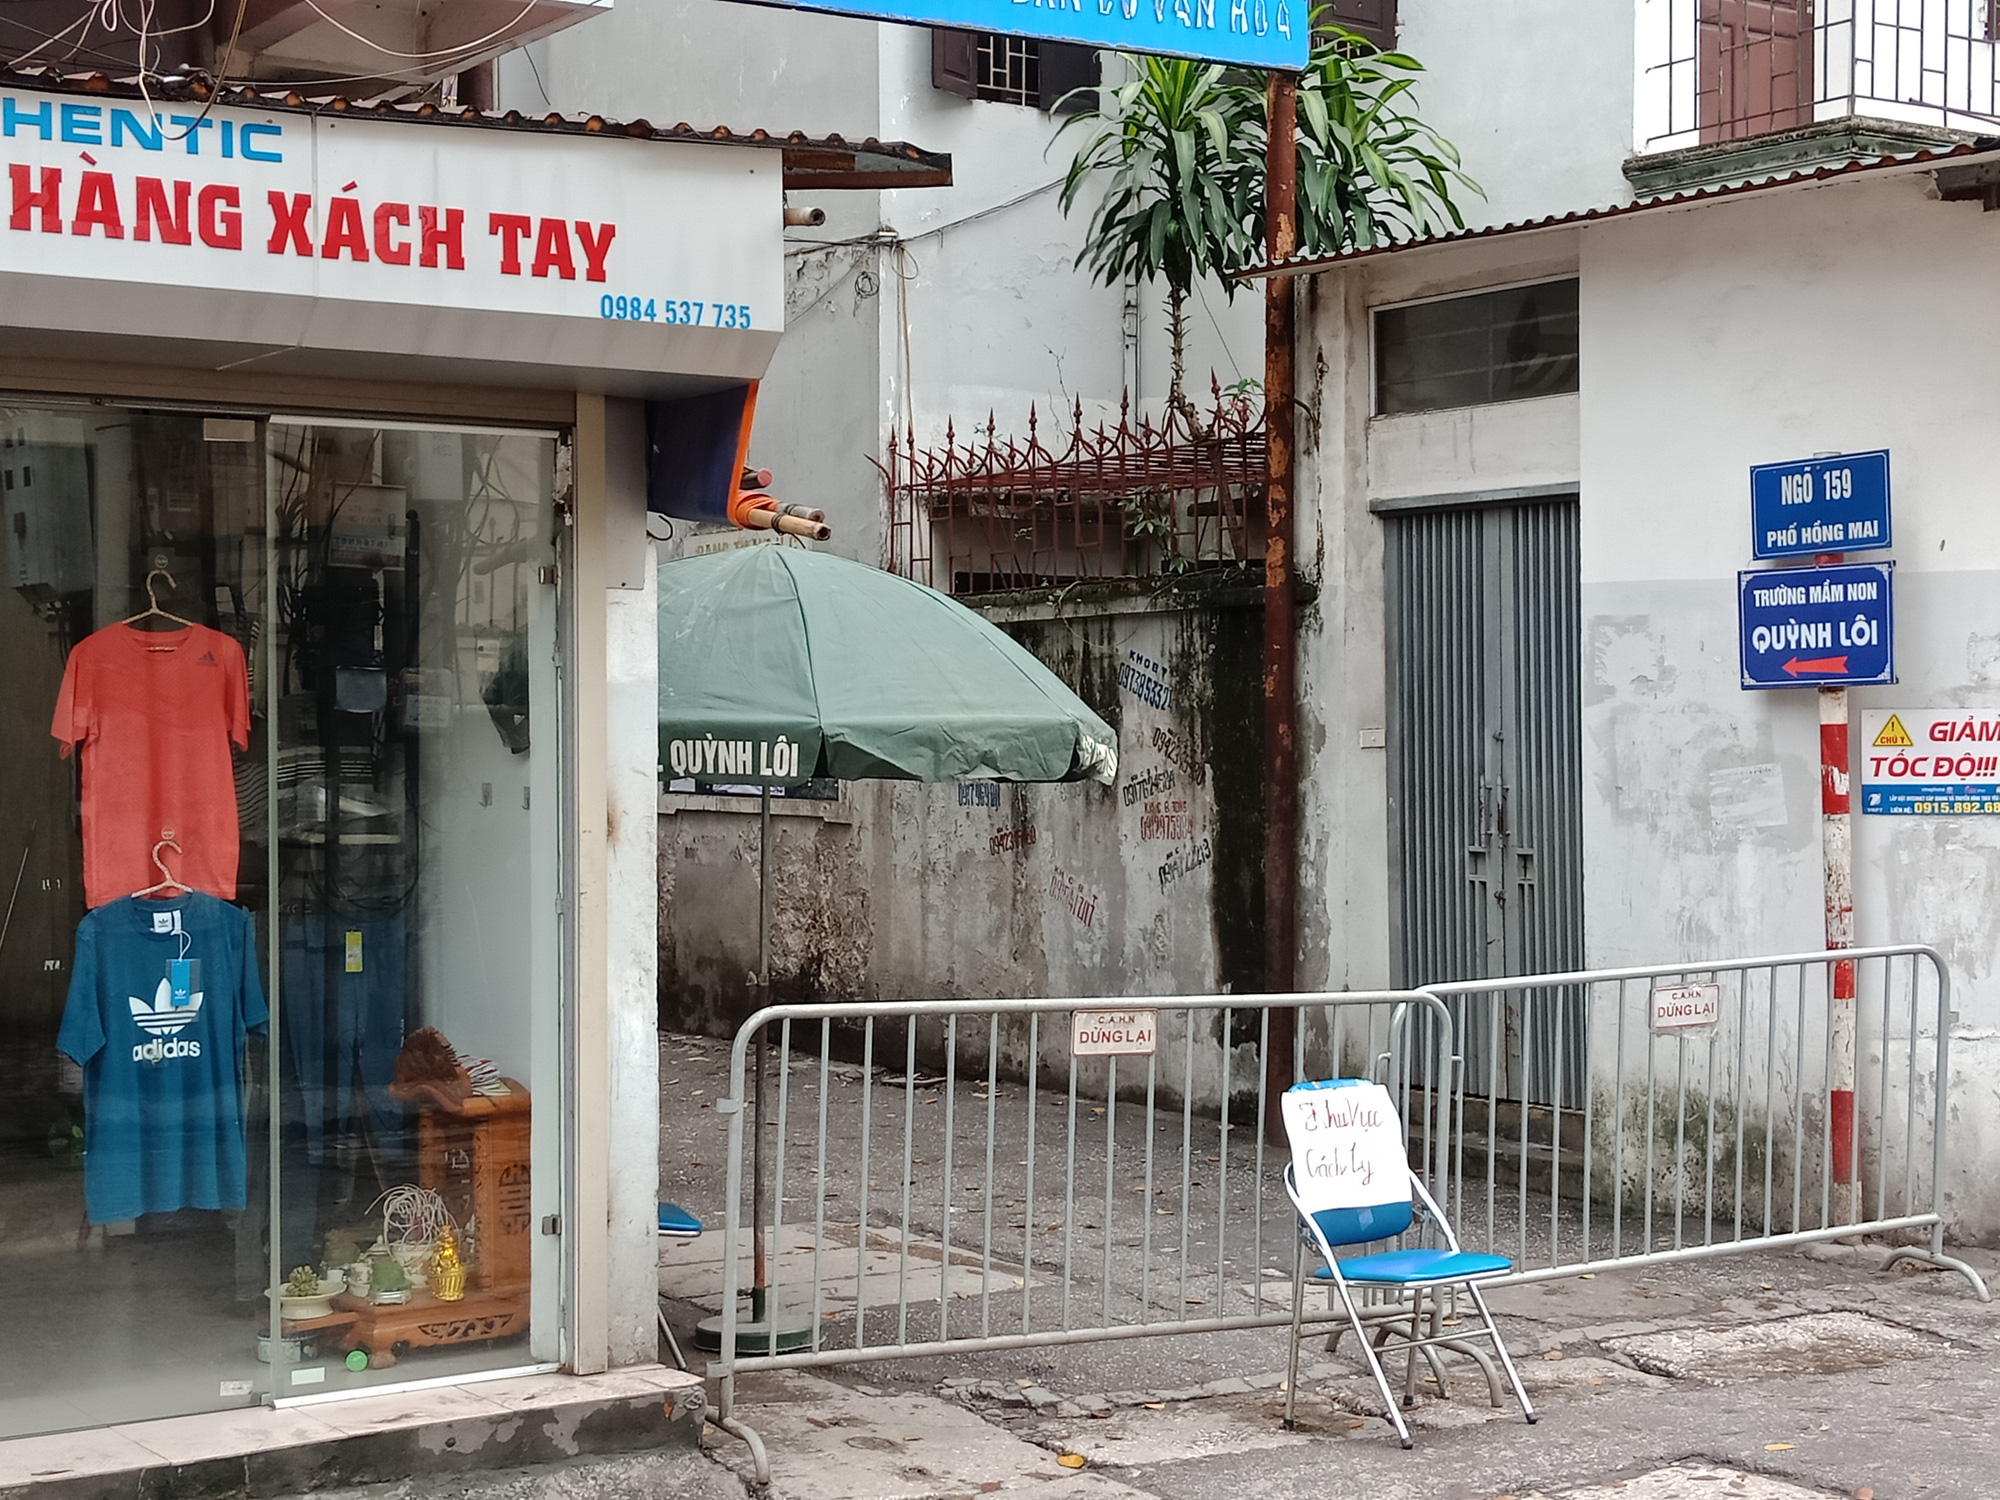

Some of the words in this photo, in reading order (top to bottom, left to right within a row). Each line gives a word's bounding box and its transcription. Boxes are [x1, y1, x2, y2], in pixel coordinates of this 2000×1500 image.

[2, 97, 283, 163] HENTIC
[9, 151, 243, 251] HÀNG
[267, 181, 466, 270] XÁCH
[489, 212, 616, 283] TAY
[600, 294, 657, 322] 0984
[665, 299, 704, 326] 537
[712, 303, 751, 330] 735
[1780, 466, 1814, 505] NGÕ
[1823, 468, 1852, 500] 159
[1767, 522, 1797, 548] PHỐ
[1848, 519, 1879, 539] MAI
[1753, 583, 1806, 608] TRƯỜNG
[1809, 579, 1844, 604] MẦM
[1847, 581, 1877, 601] NON
[1752, 618, 1832, 653] QUỲNH
[1839, 614, 1878, 646] LÔI
[1929, 715, 2000, 742] GIẢM
[670, 733, 752, 776] QUỲNH
[759, 735, 799, 778] LÔI
[1870, 748, 1929, 777] TỐC
[1932, 752, 1998, 781] ĐỘ!!!
[1914, 802, 2000, 814] 0915.892.68
[1658, 1002, 1692, 1018] DỪNG
[1694, 1002, 1714, 1017] LẠI
[133, 1037, 201, 1062] adidas
[1080, 1026, 1123, 1043] DỪNG
[1126, 1029, 1151, 1046] LẠI
